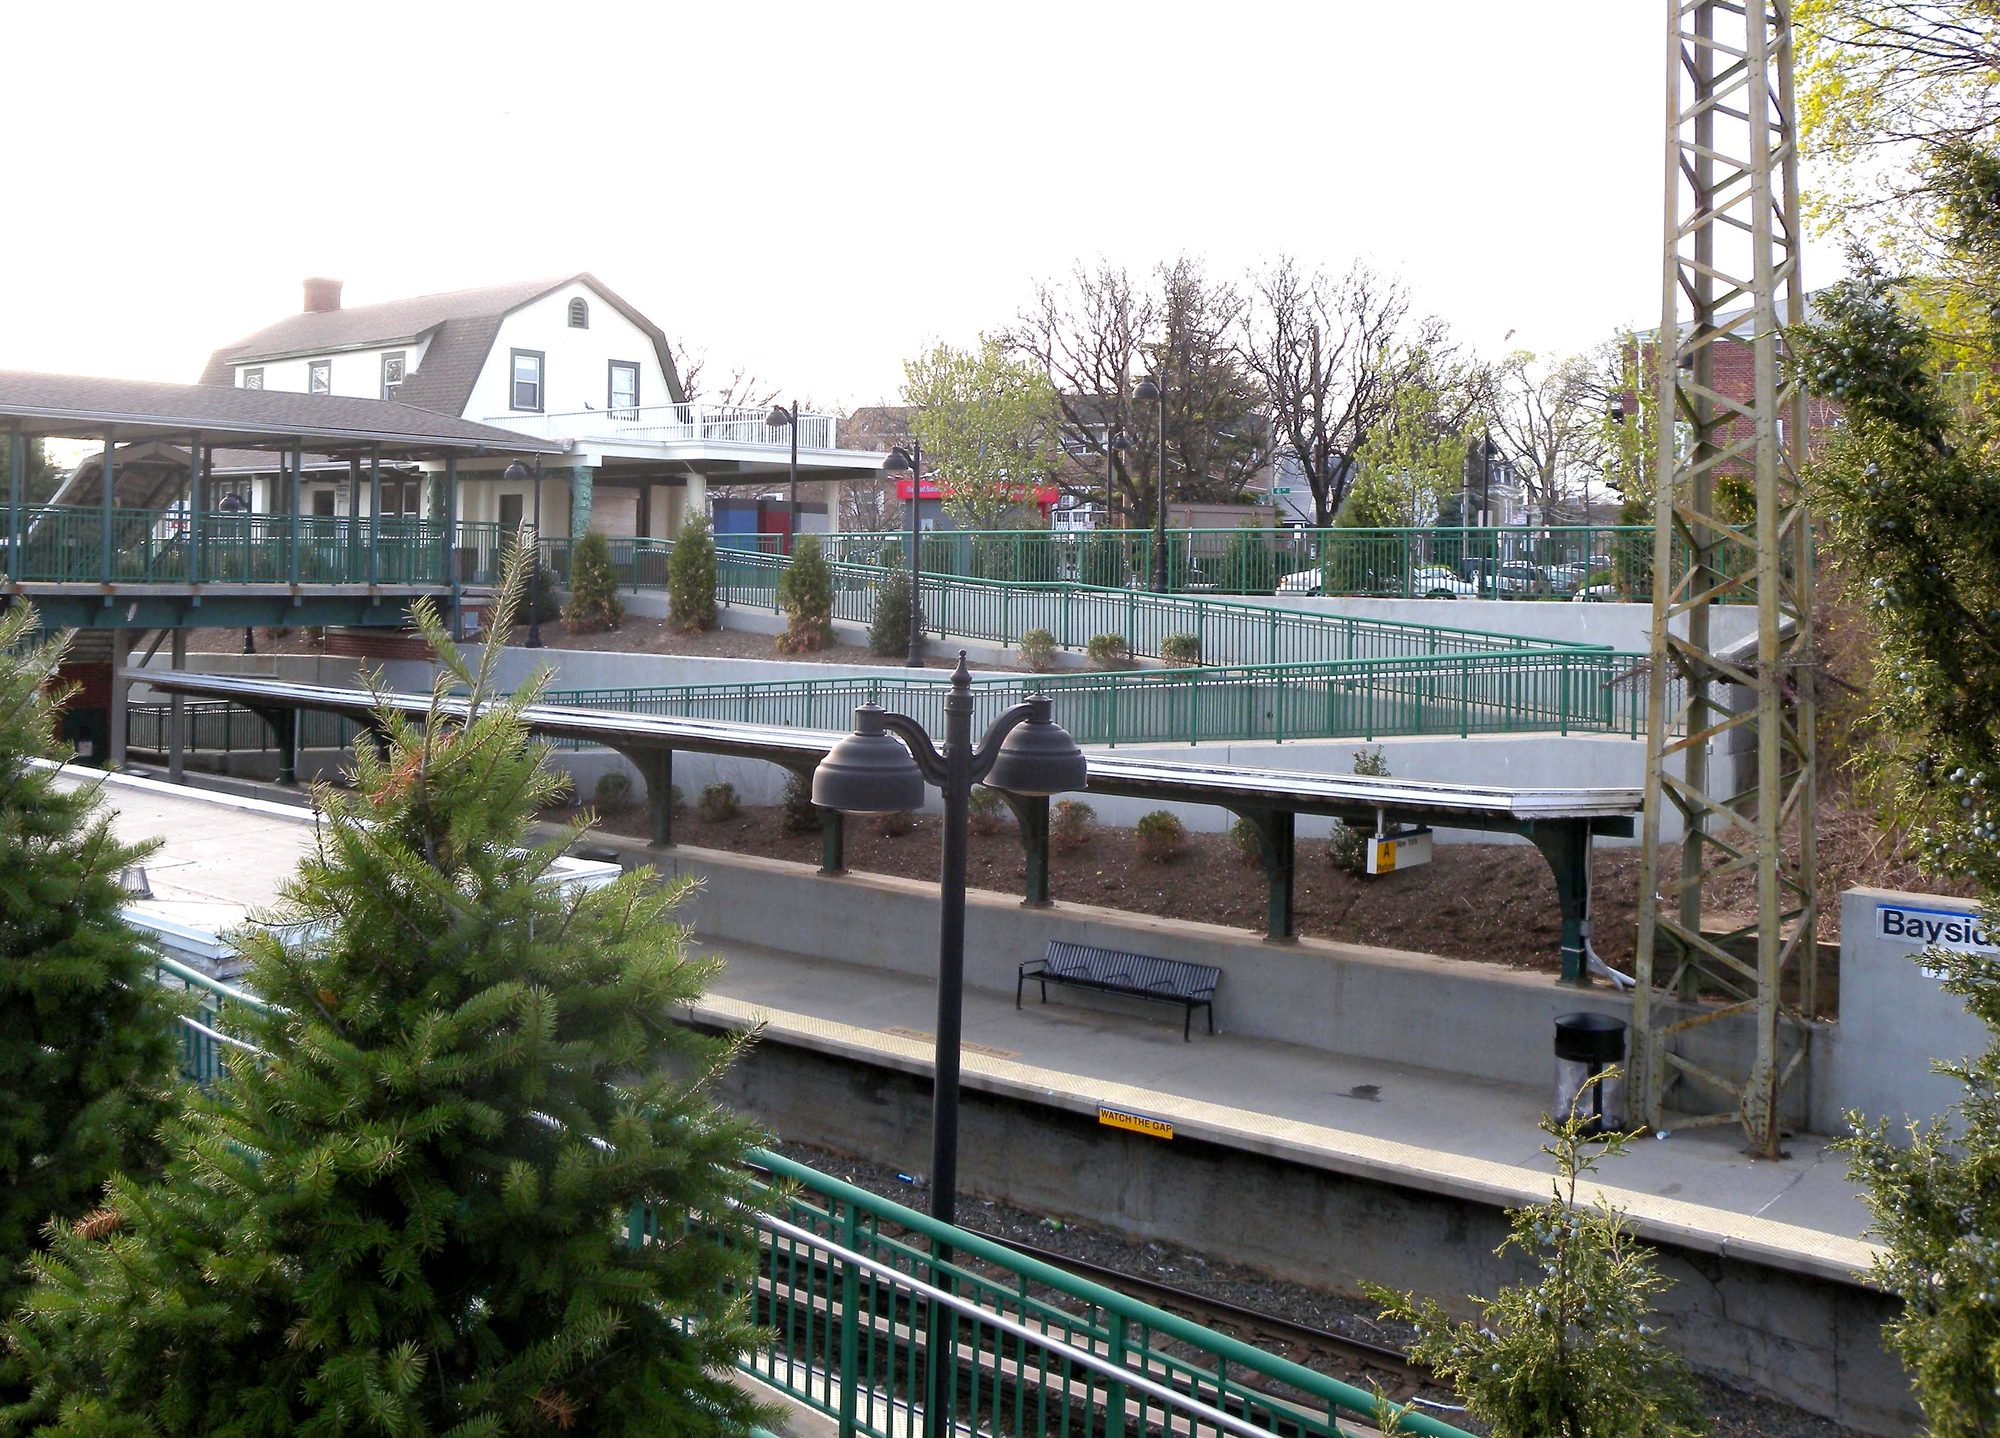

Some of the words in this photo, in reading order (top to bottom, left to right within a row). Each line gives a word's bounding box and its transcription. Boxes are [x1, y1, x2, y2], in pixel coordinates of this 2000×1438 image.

[1383, 843, 1390, 858] A
[1883, 909, 2000, 947] Baysid
[1101, 1109, 1131, 1124] WATCH
[1133, 1116, 1151, 1128] THE
[1153, 1121, 1172, 1132] GAP
